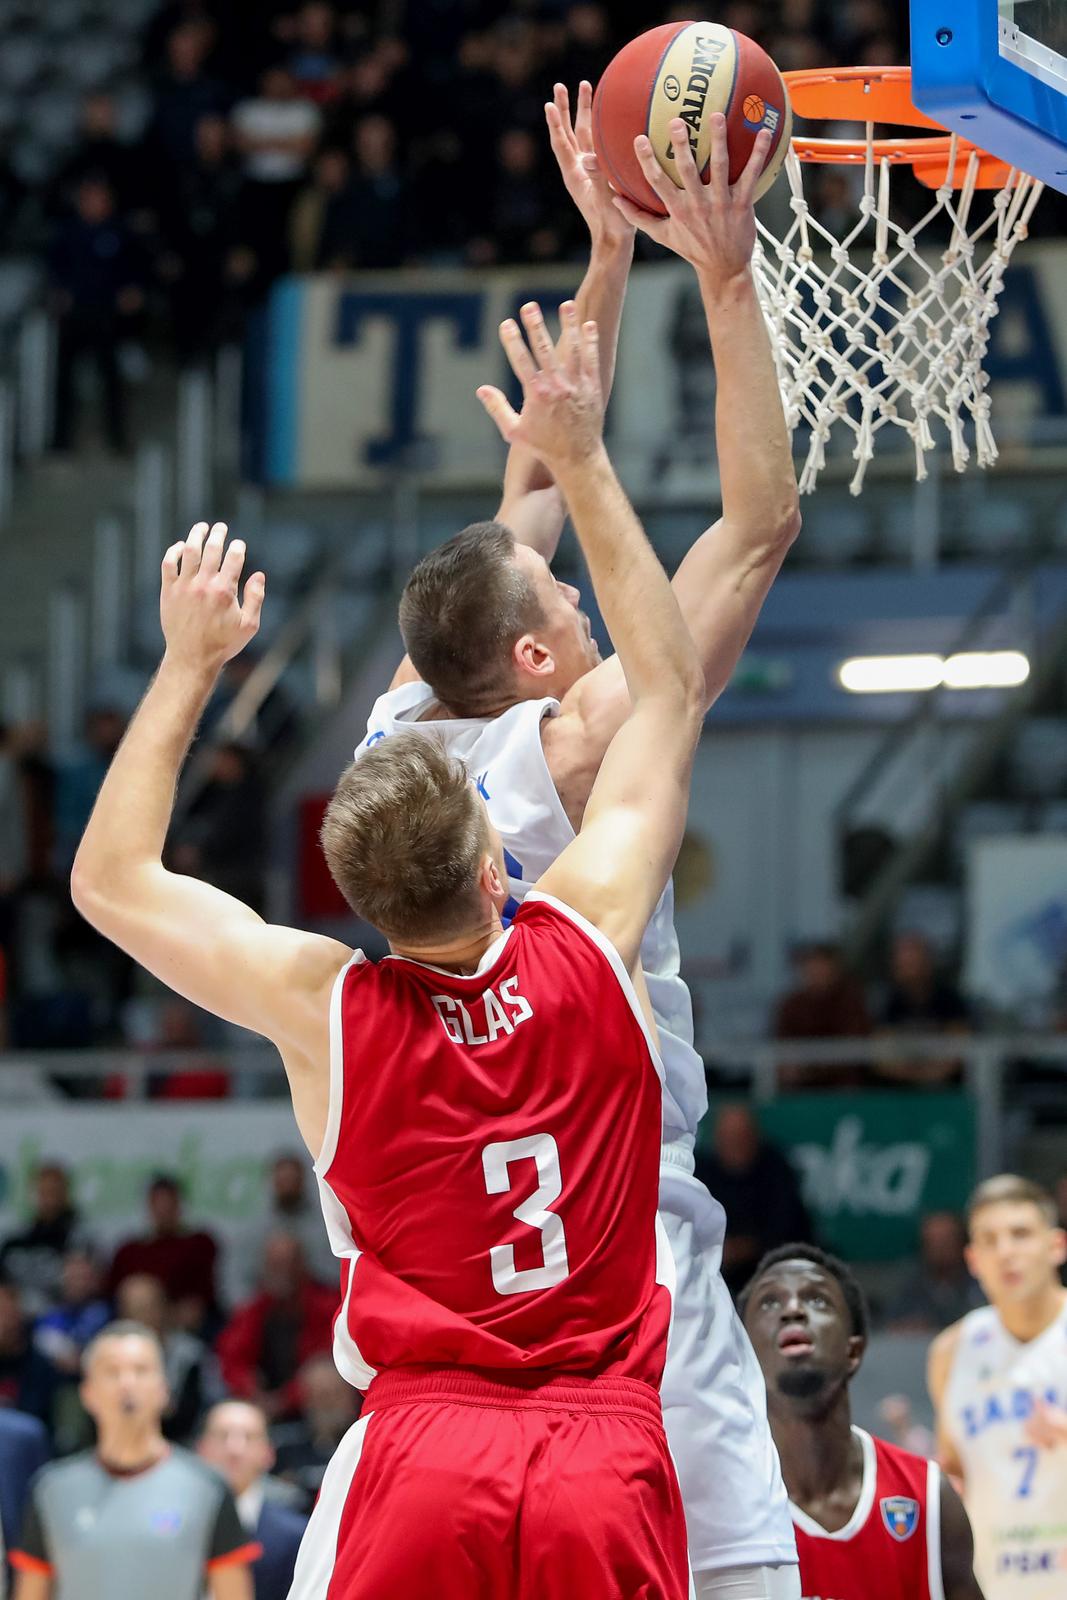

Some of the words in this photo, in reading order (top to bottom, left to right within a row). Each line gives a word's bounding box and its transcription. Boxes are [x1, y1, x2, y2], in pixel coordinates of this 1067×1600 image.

[666, 36, 727, 161] ALDING
[762, 109, 780, 134] BA
[431, 974, 534, 1046] GLAS
[482, 1132, 569, 1296] 3
[1012, 1446, 1039, 1499] 7
